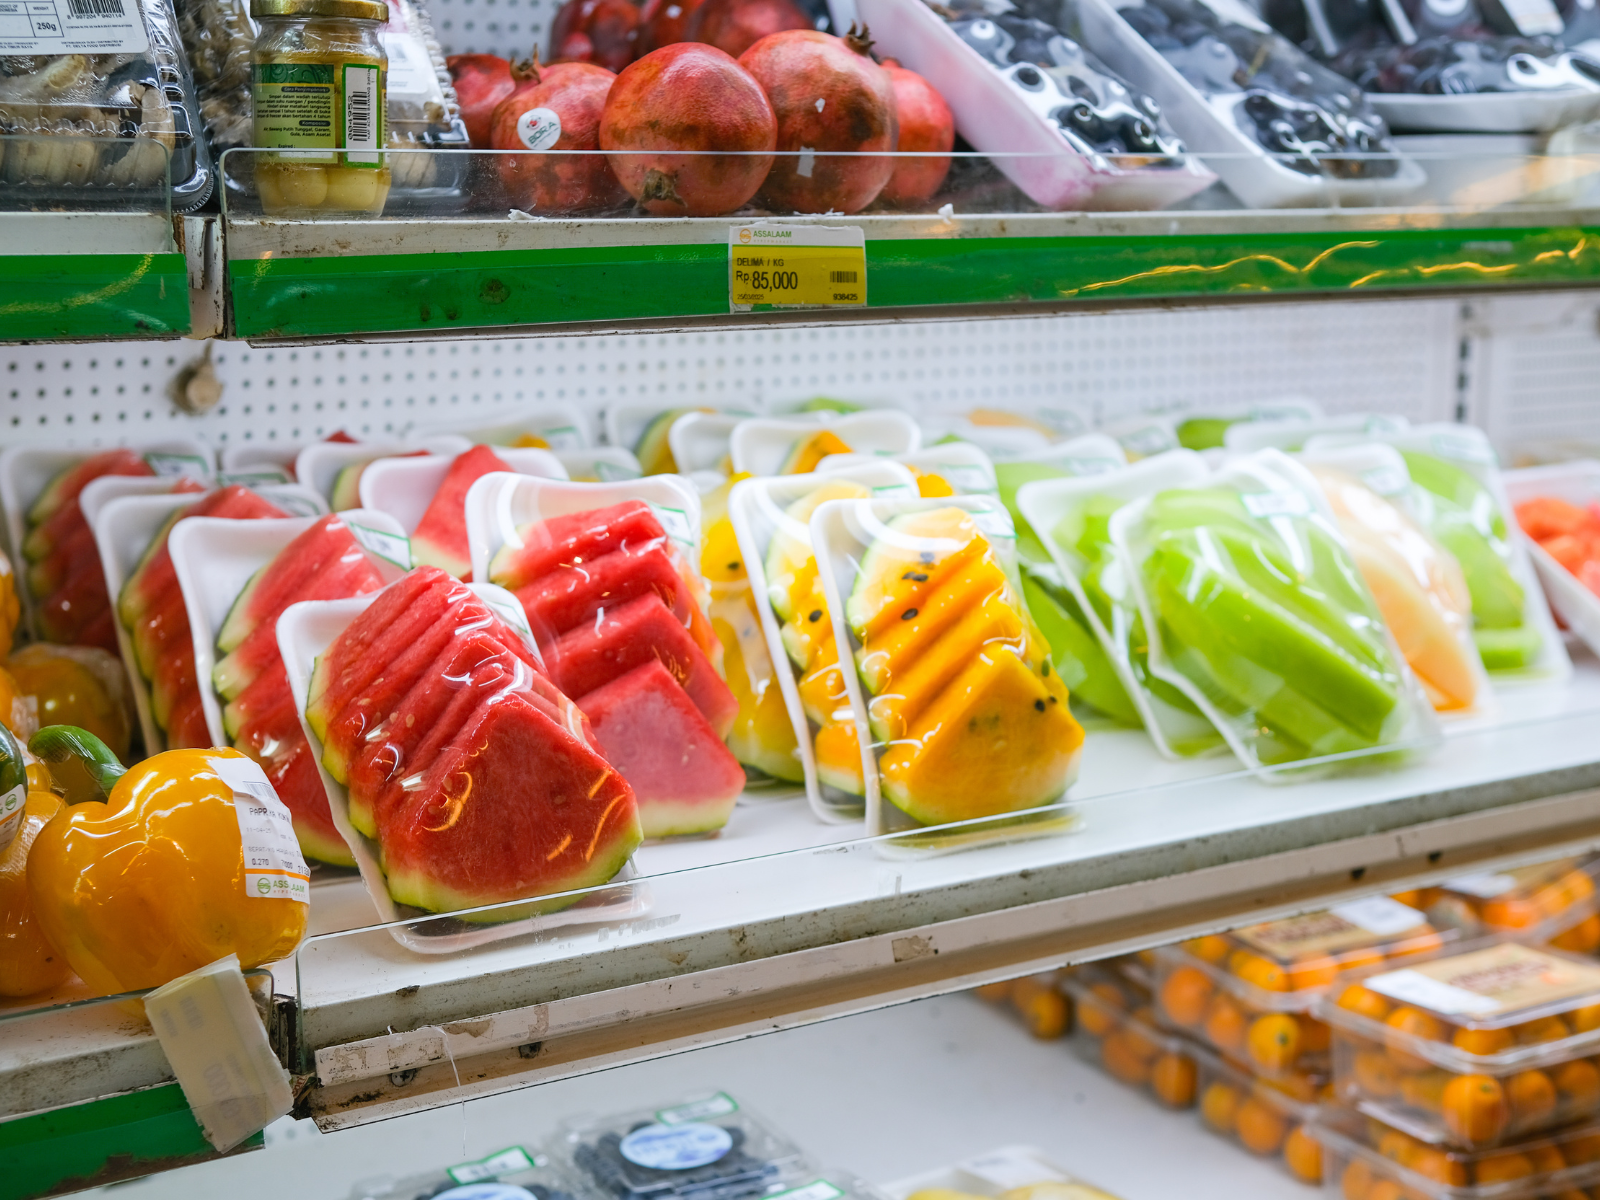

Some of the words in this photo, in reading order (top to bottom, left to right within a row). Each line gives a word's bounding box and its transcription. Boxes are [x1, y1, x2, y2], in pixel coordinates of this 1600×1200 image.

[36, 22, 56, 31] 250g
[528, 122, 556, 144] BORA
[736, 258, 764, 266] DELIMA
[773, 258, 784, 267] KG
[752, 271, 798, 292] 85,000
[272, 880, 305, 893] ASSAAM
